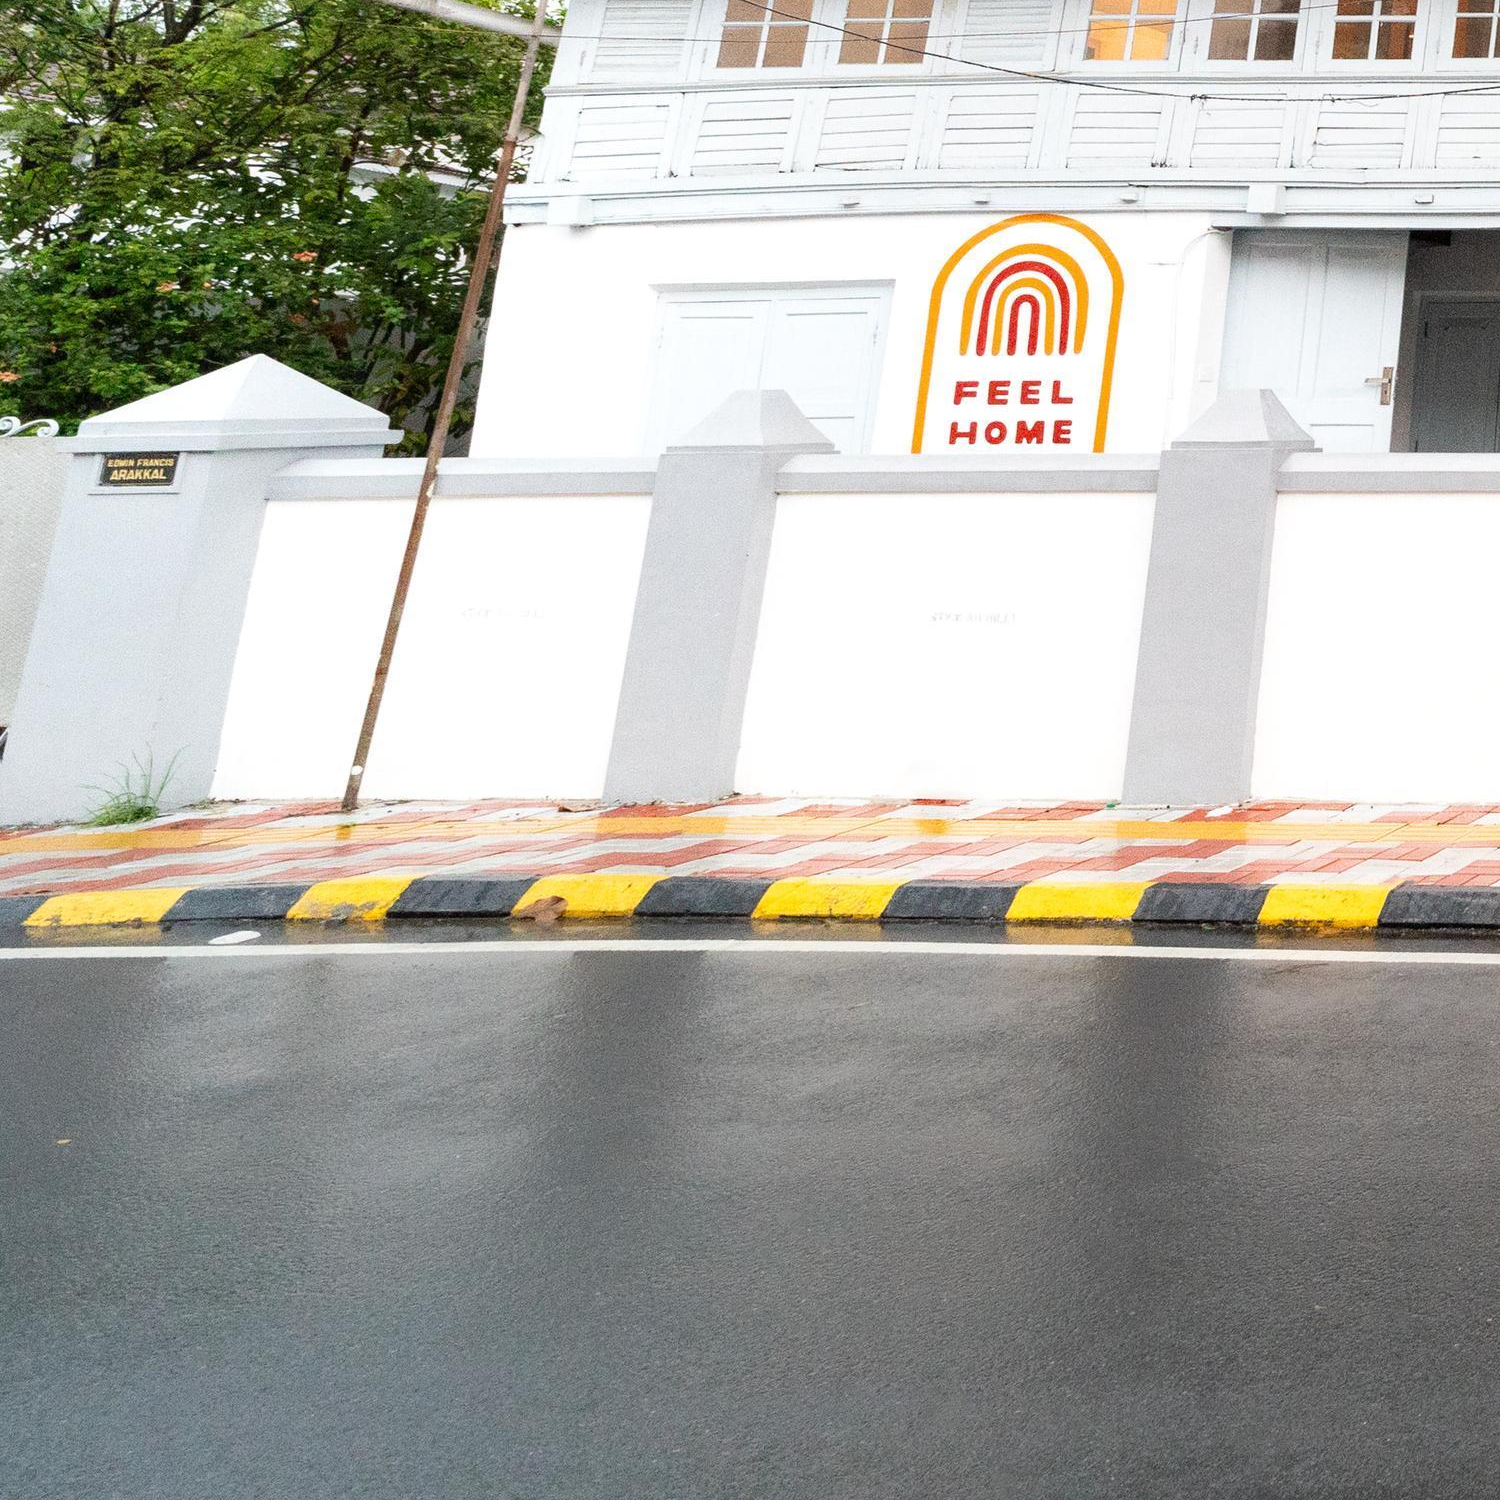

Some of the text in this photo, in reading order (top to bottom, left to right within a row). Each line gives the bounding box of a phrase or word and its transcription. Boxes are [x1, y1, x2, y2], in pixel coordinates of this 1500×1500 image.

[953, 380, 1074, 406] FEEL
[948, 419, 1073, 445] HOME
[136, 457, 175, 467] FRANCIS
[109, 468, 167, 481] ARAKKAL
